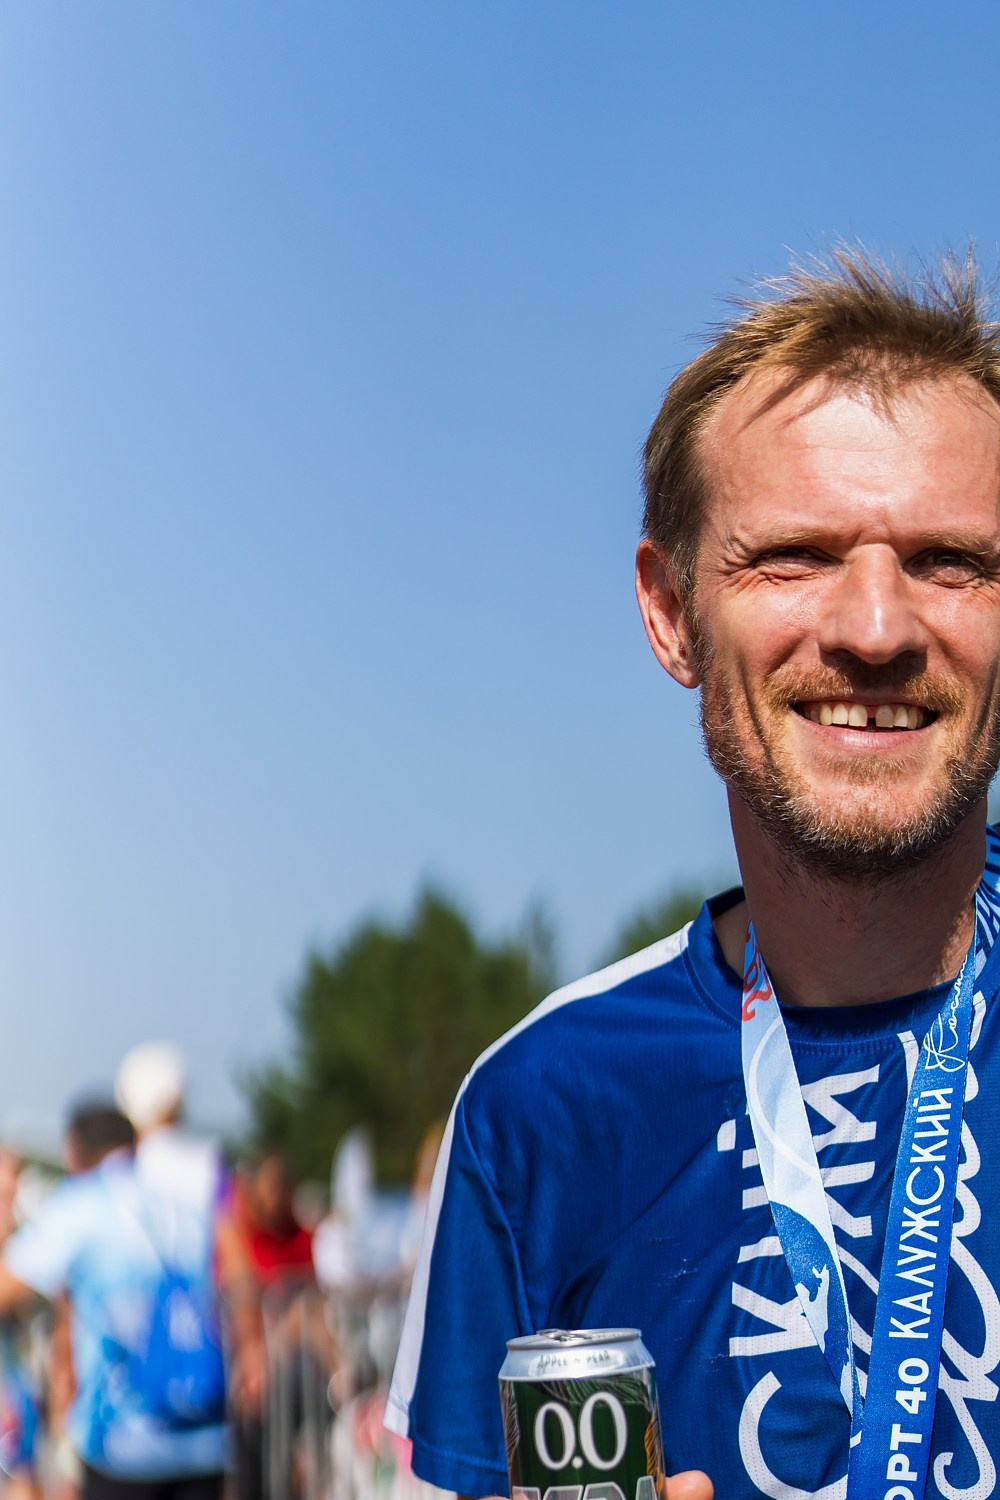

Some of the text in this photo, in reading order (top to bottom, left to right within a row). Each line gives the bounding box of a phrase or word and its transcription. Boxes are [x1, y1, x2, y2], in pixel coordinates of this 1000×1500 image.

[888, 1085, 955, 1339] КАЛУЖСКИЙ
[895, 1357, 931, 1418] 40
[534, 1391, 628, 1471] 0.0
